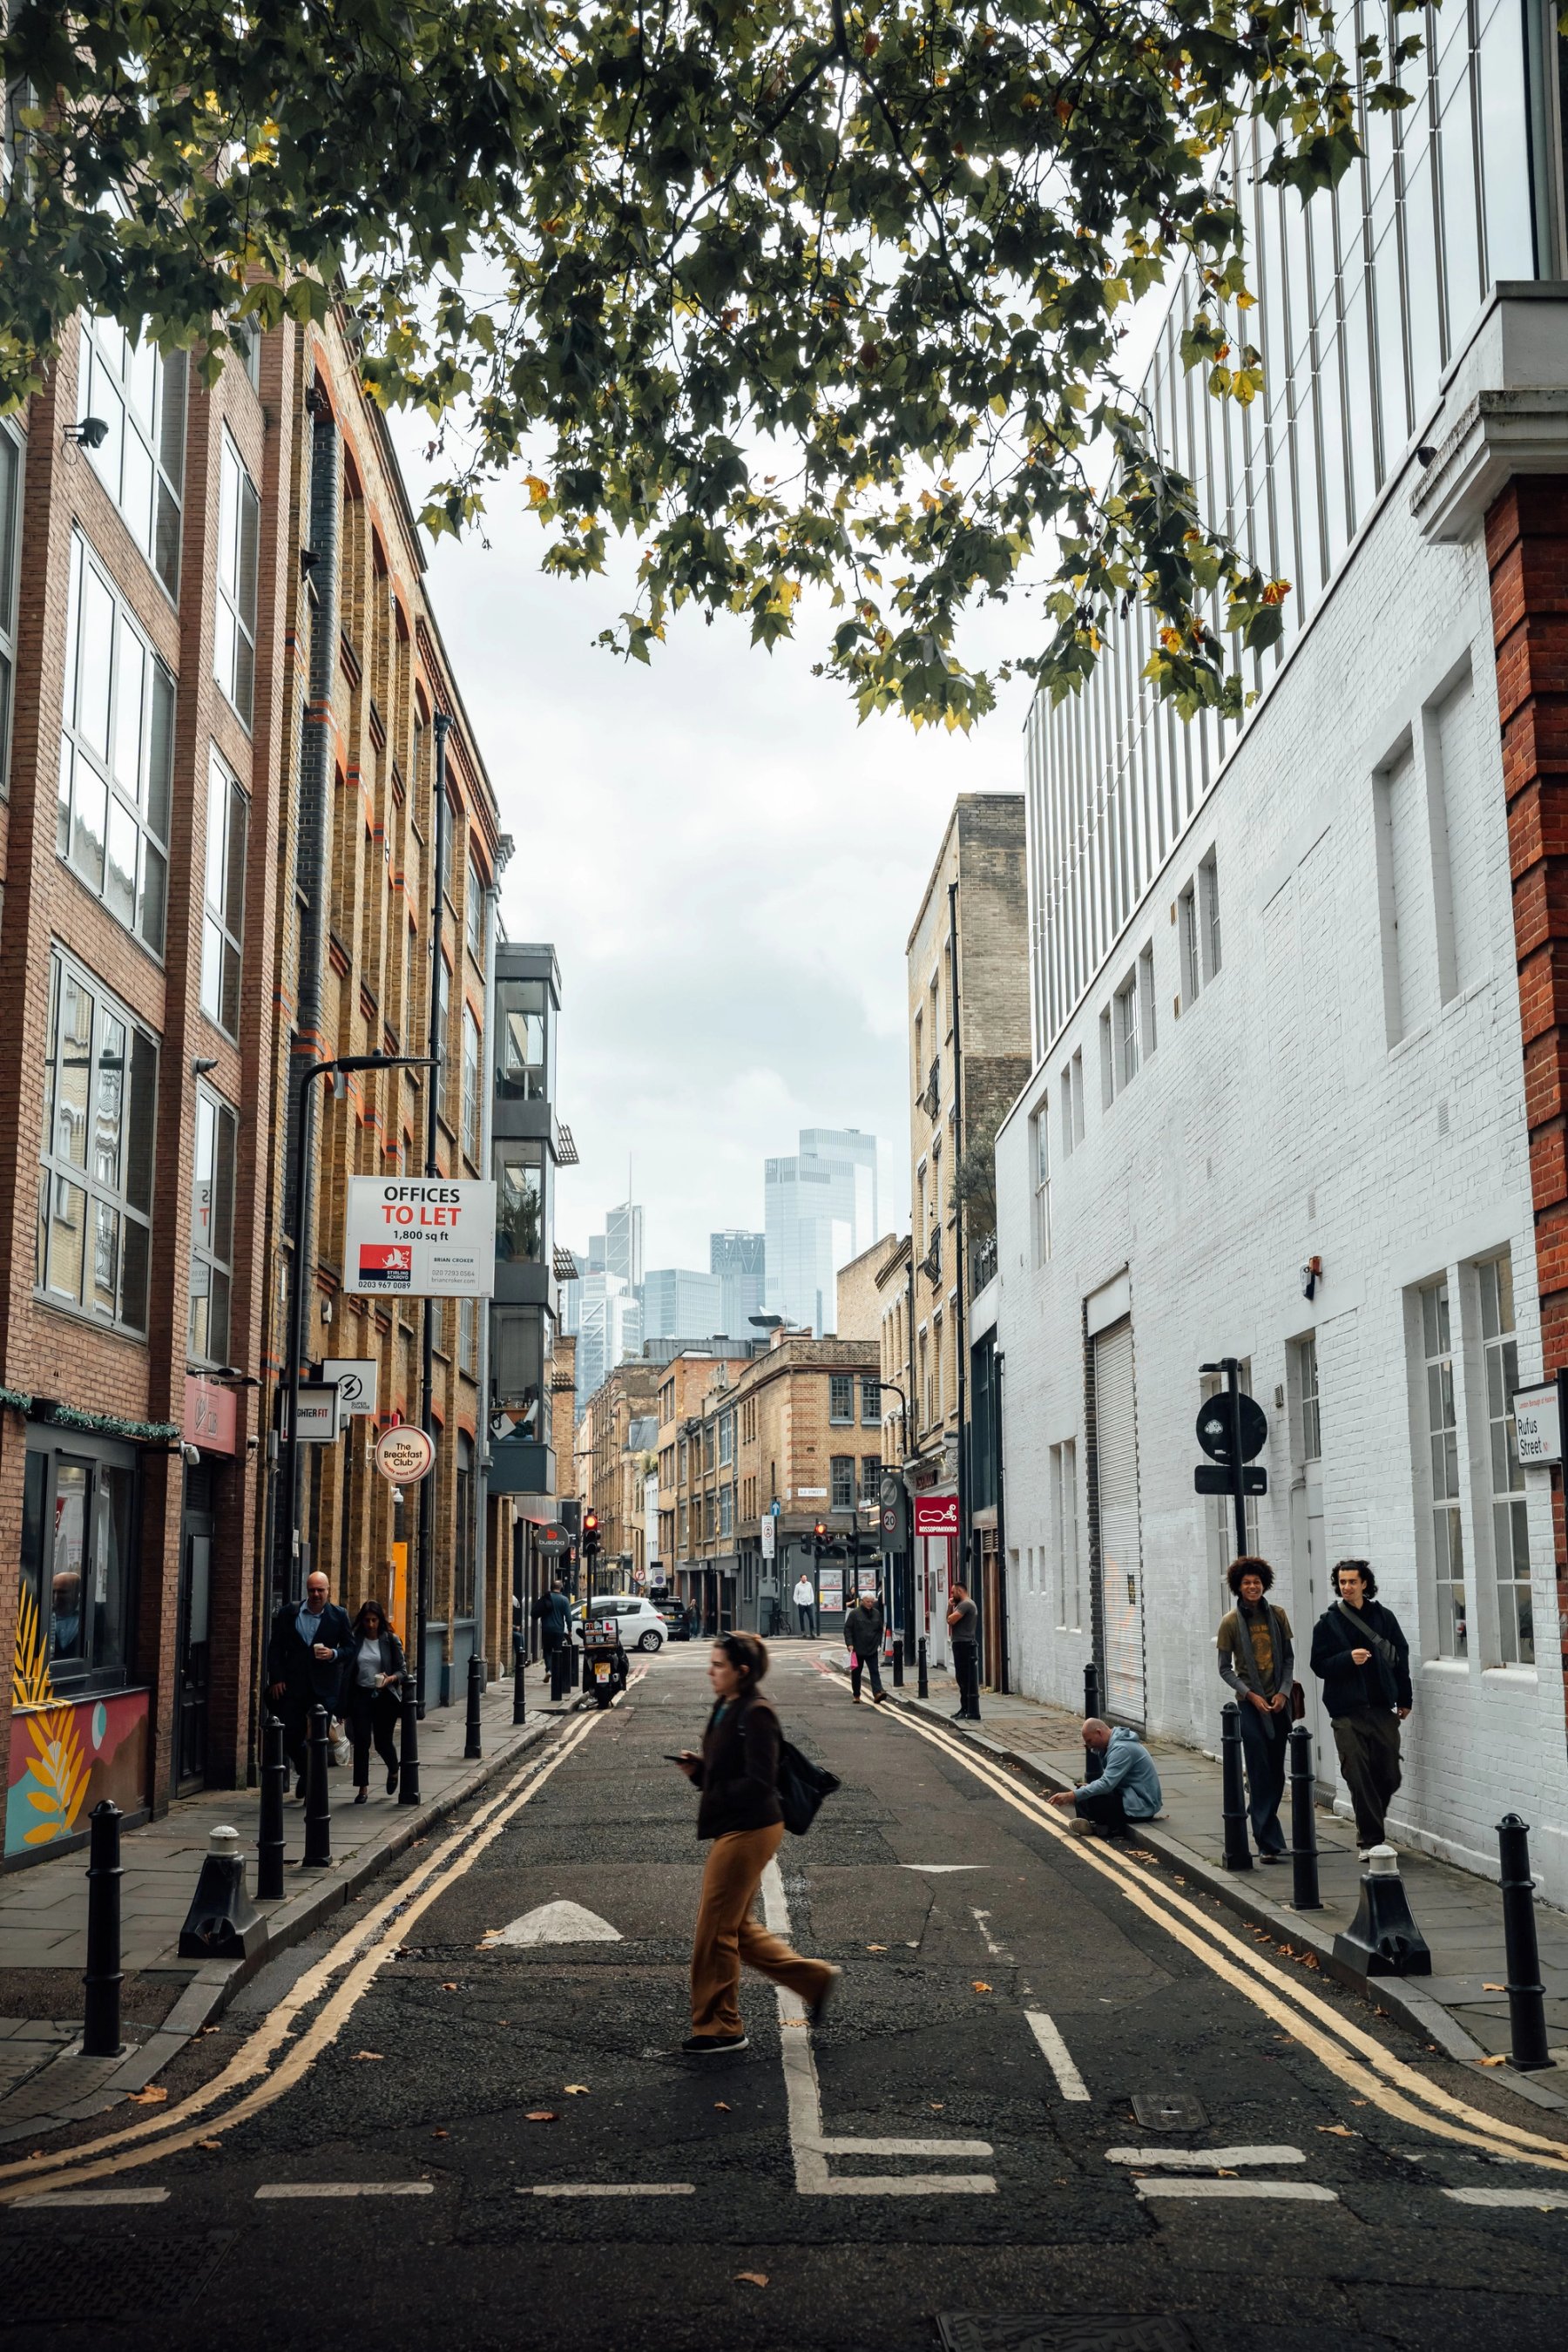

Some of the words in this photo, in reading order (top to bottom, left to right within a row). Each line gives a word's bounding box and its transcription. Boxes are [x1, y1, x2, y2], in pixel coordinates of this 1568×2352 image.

[384, 1186, 460, 1203] OFFICES
[382, 1206, 414, 1225] TO
[420, 1206, 462, 1227] LET
[394, 1230, 422, 1240] 1,800
[425, 1233, 437, 1242] sq
[440, 1231, 449, 1240] ft
[297, 1409, 317, 1417] GHTER
[318, 1409, 328, 1417] FIT
[1517, 1417, 1538, 1436] Rufus
[1520, 1436, 1542, 1456] Street
[884, 1516, 895, 1525] 20
[605, 1622, 613, 1632] L
